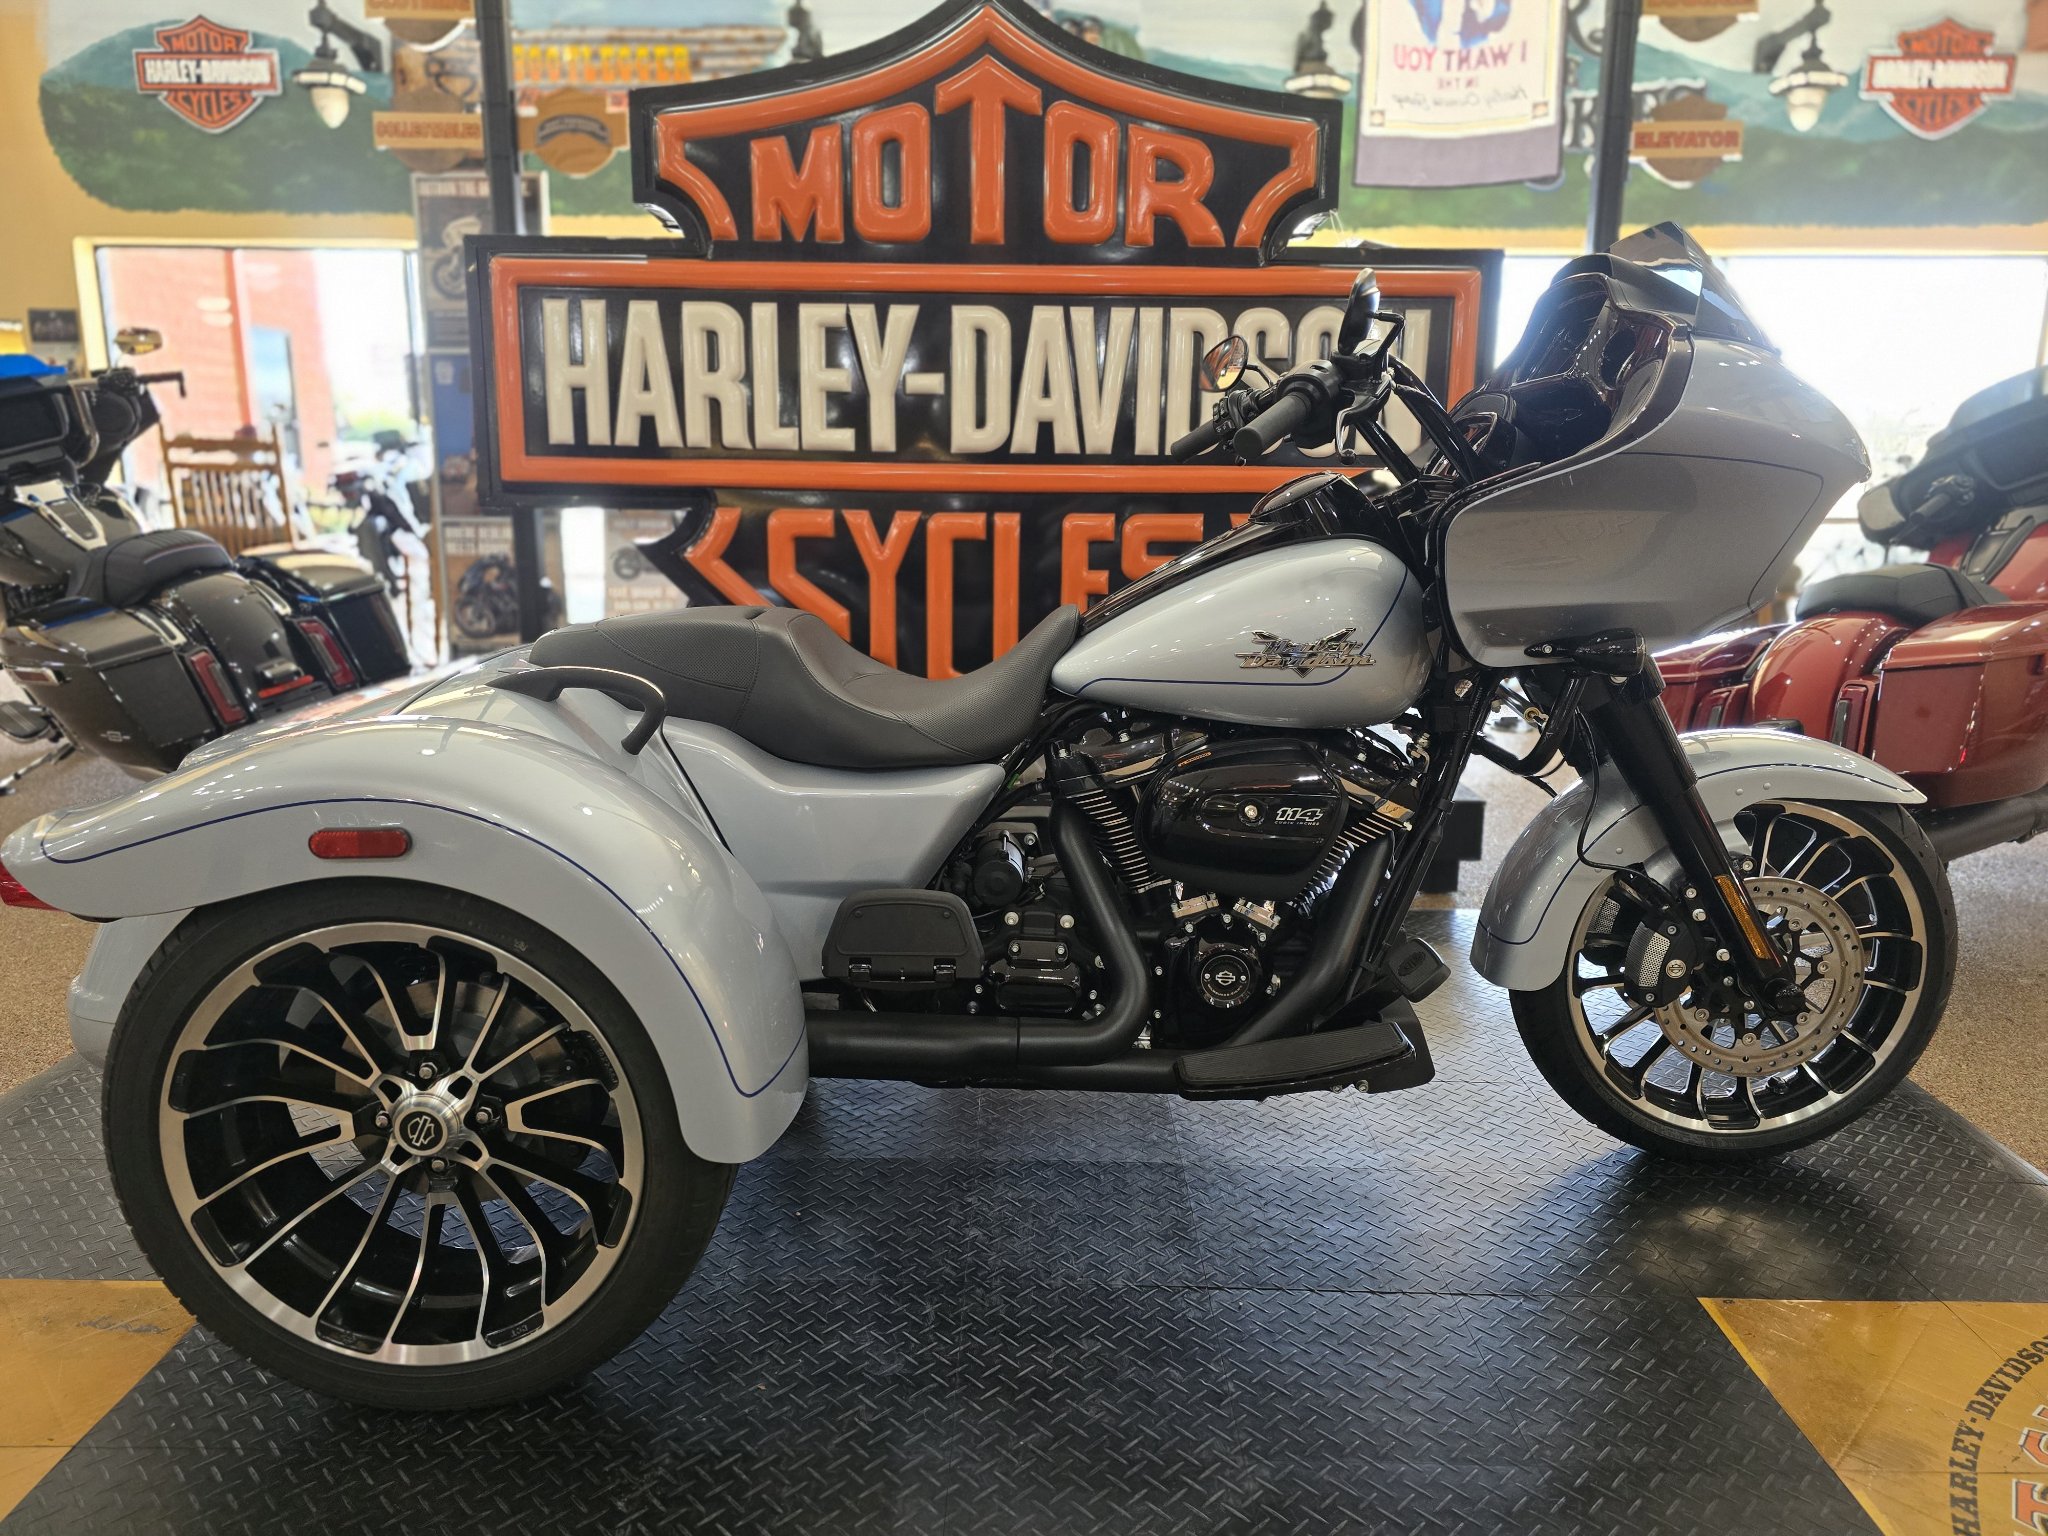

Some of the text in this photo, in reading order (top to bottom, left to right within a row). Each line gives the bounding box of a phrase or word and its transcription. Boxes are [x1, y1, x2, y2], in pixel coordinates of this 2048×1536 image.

[171, 25, 237, 52] MOTOR
[749, 54, 1226, 248] MOTOR
[1634, 131, 1739, 148] ELEVATOR
[1276, 807, 1324, 822] 114
[1948, 1333, 2048, 1536] HARLEY-DAVIDSO
